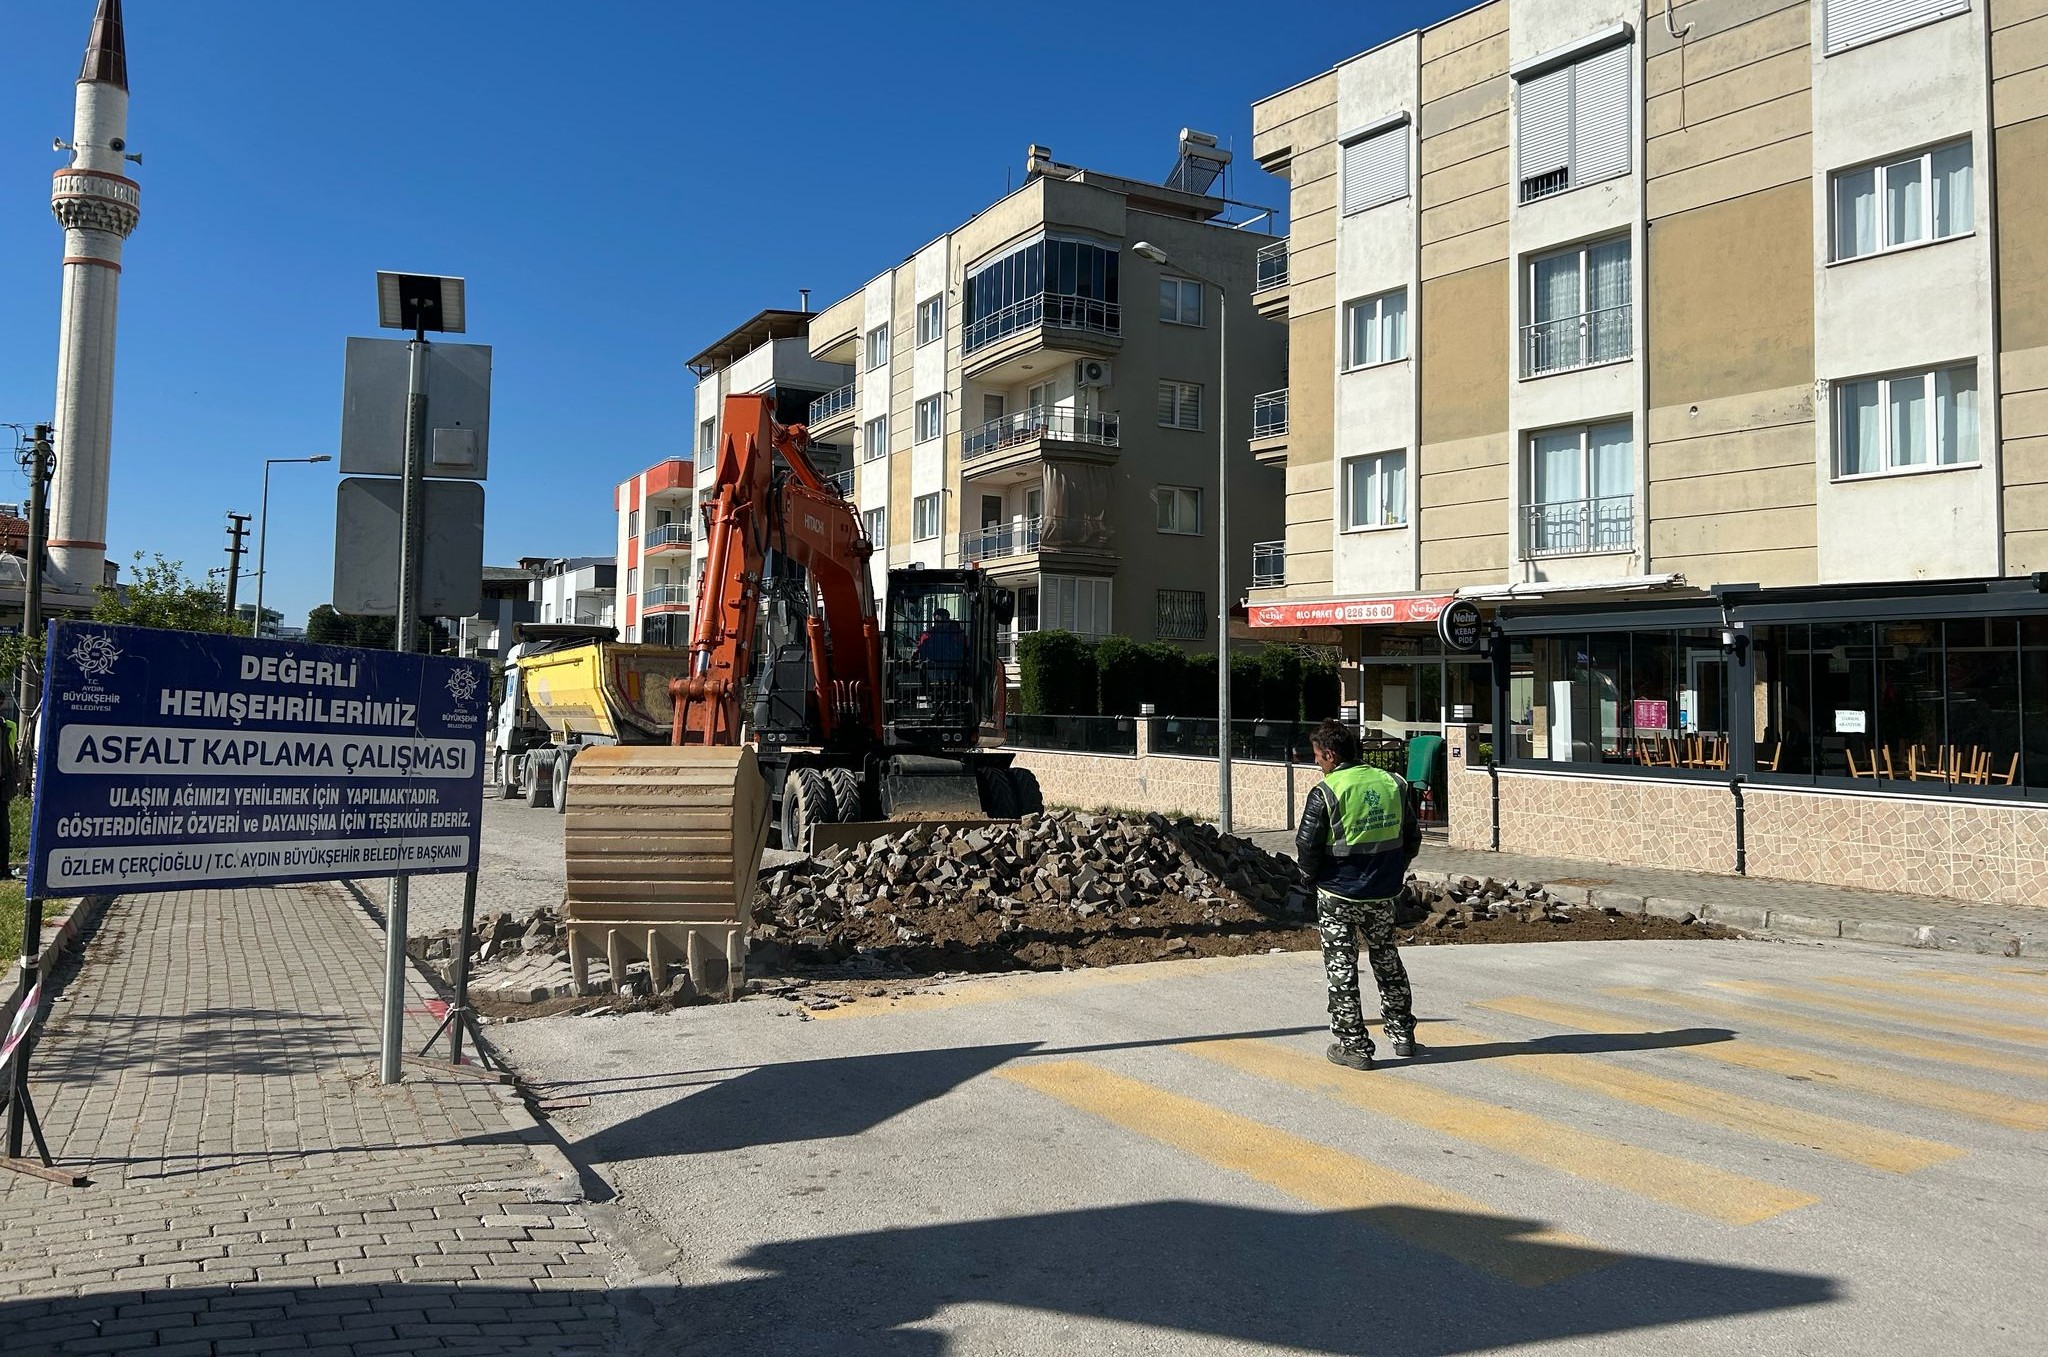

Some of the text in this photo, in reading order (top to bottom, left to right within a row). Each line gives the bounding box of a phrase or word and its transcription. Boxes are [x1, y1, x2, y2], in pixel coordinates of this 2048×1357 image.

[1296, 611, 1310, 619] ALO
[1312, 610, 1333, 619] PAKET
[1346, 607, 1363, 618] 226
[1381, 606, 1392, 616] 60
[1453, 612, 1477, 623] Nehir
[1454, 627, 1476, 636] KEBAP
[1458, 636, 1473, 644] PİDE
[240, 651, 357, 688] DEĞERLİ
[62, 691, 121, 704] BÜYÜKŞEHİR
[71, 704, 112, 712] BELEDİYESİ
[160, 689, 416, 727] HEMŞEHRİLERİMİZ
[442, 713, 478, 723] BÜYÜKŞEHİR
[75, 735, 466, 775] ASFALT KAPLAMA ÇALIŞMASI
[109, 782, 439, 811] ULAŞIM AĞIMIZI YENİLEMEK İÇİN YAPILMAKTADIR.
[57, 808, 471, 838] GÖSTERDİĞİNİZ ÖZVERİ ve DAYANIŞMA İÇİN TEŞEKKÜR EDERİZ.
[61, 843, 462, 878] ÖZLEM ÇERÇİOĞLU / T.C. AYDIN BÜYÜKŞEHİR BELEDİYE BAŞKANI
